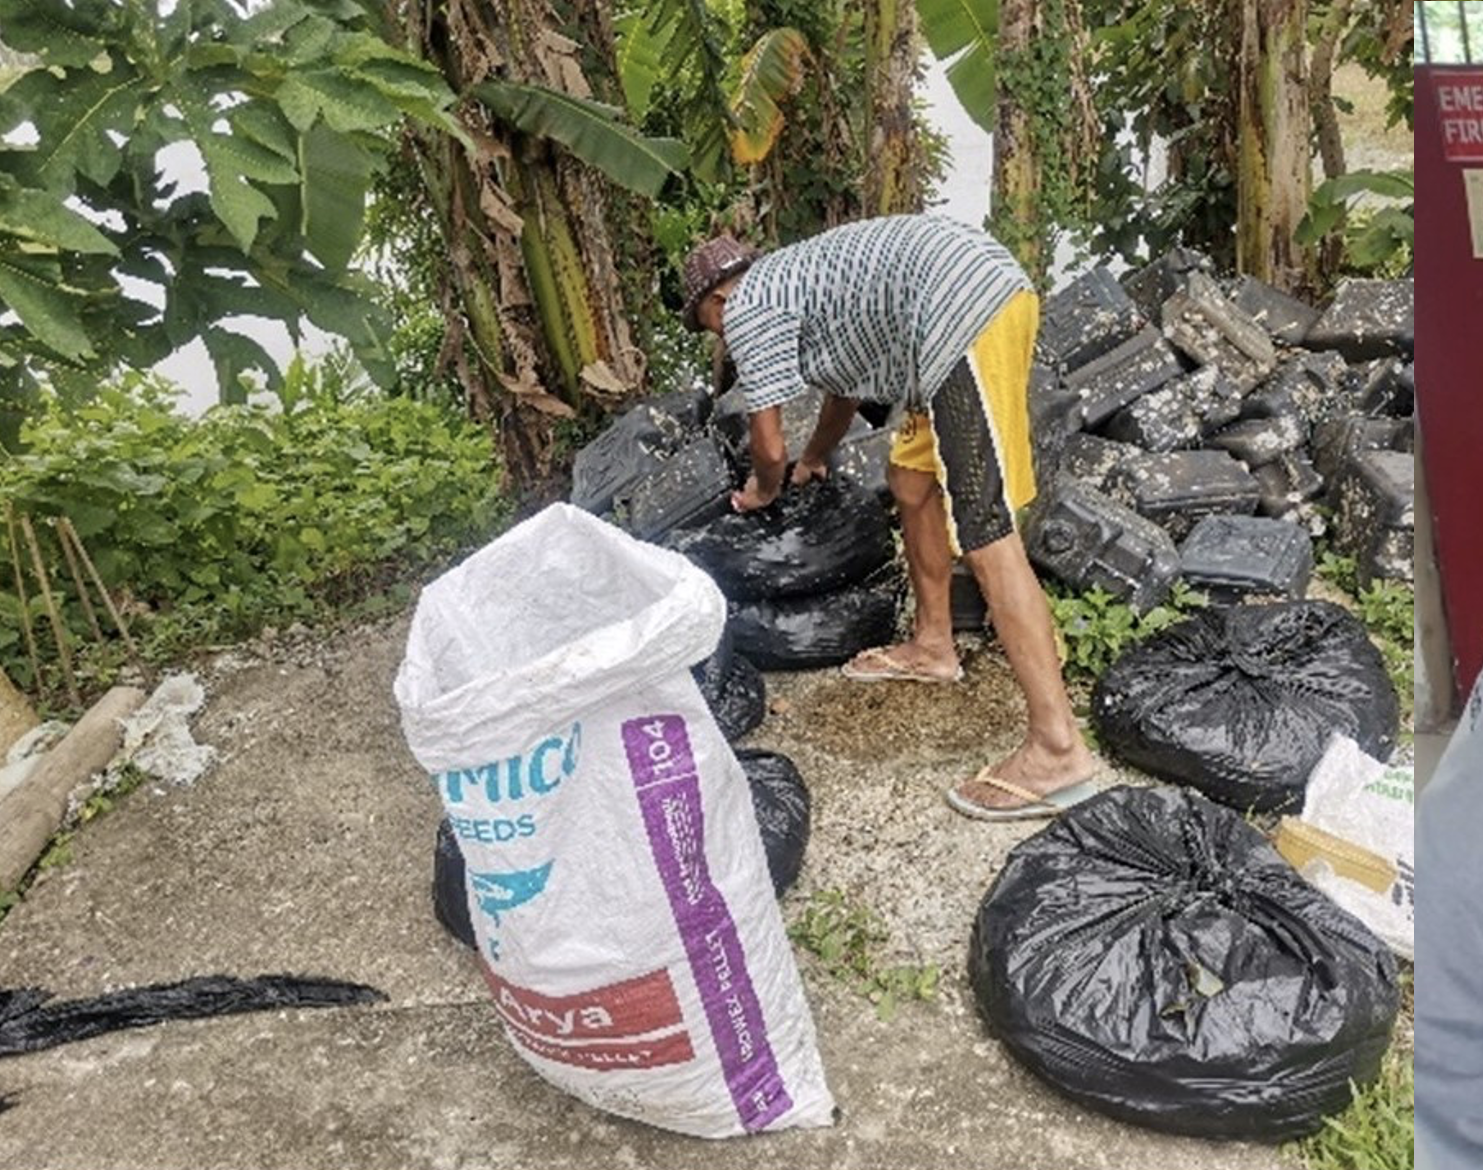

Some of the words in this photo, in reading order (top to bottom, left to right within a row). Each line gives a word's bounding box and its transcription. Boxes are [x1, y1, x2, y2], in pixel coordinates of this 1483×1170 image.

[430, 721, 582, 803] MICO
[641, 719, 684, 775] 104
[500, 986, 614, 1034] Arya
